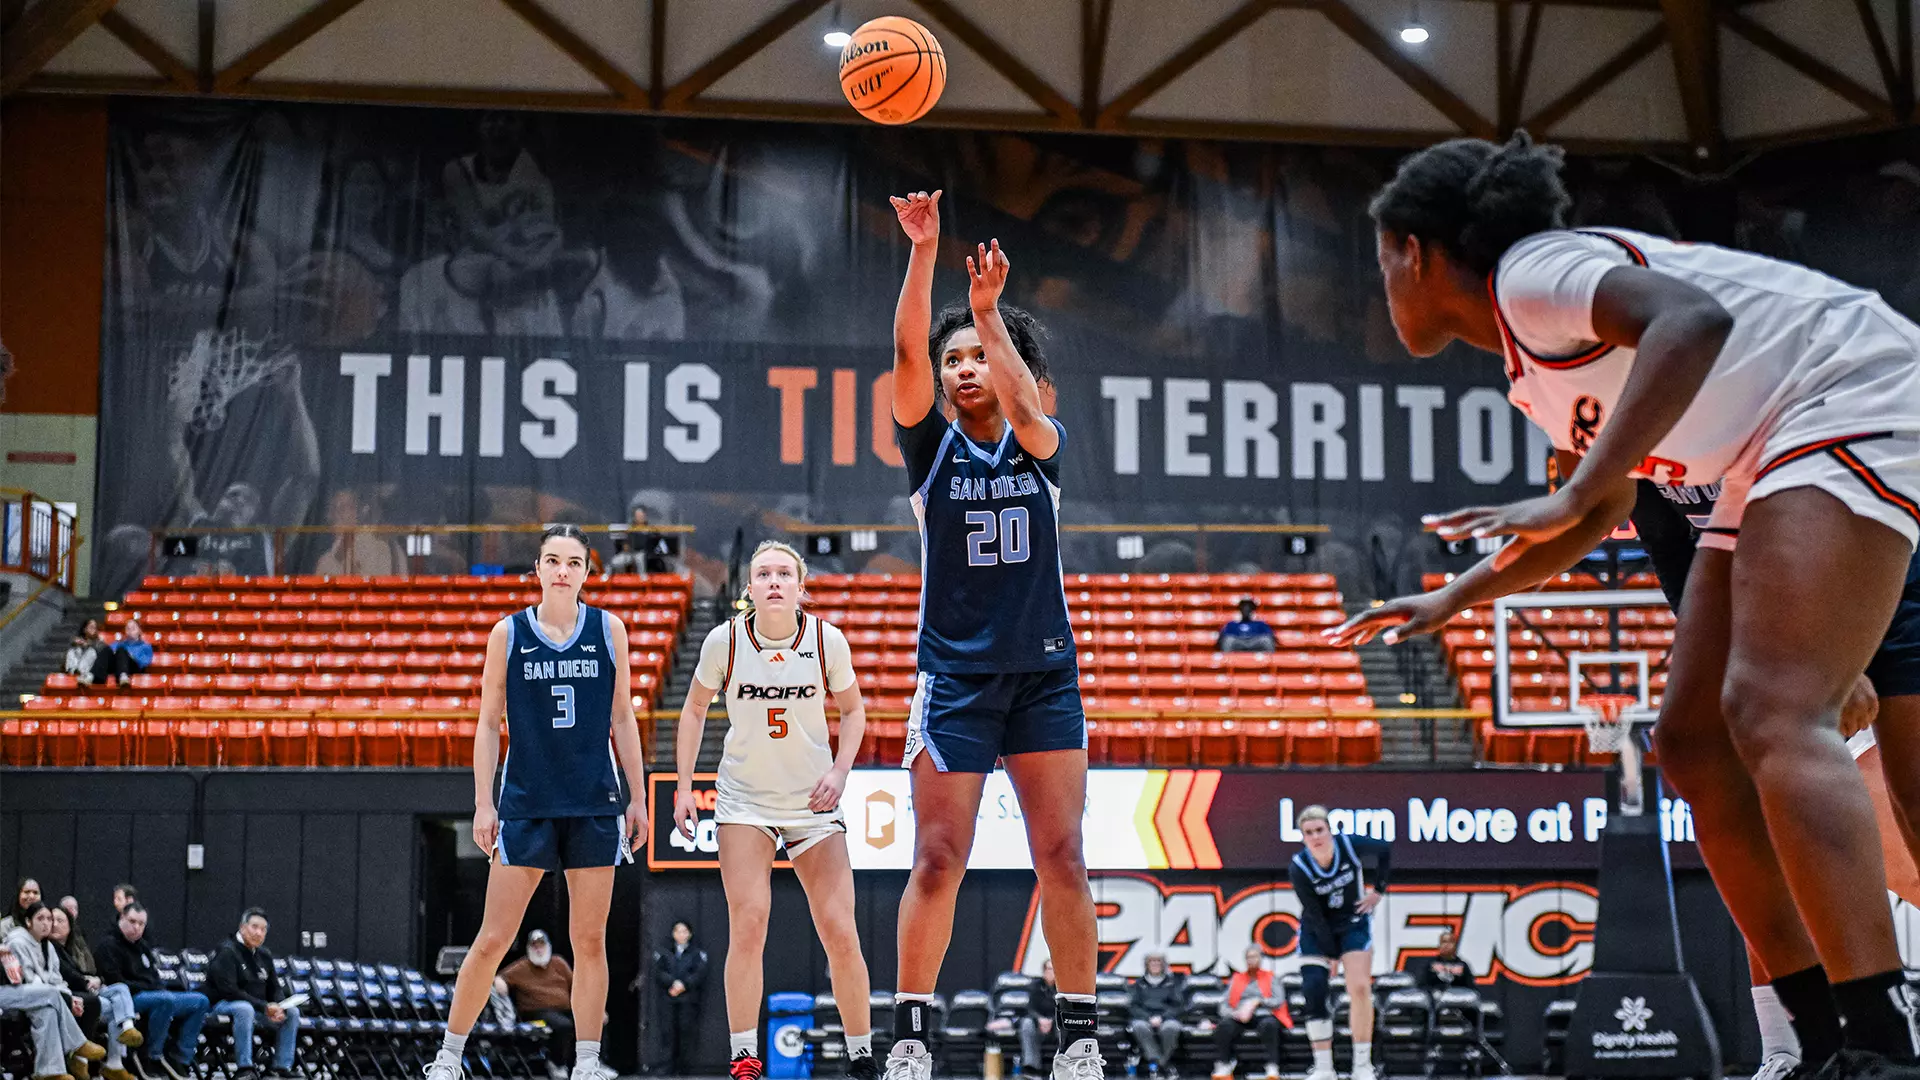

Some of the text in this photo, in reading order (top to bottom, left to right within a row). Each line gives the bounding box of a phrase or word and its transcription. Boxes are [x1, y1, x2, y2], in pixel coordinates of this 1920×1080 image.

[340, 353, 578, 459] THIS
[623, 362, 722, 463] IS
[950, 472, 1040, 500] SAN DIEGO
[965, 506, 1030, 567] 20
[524, 660, 599, 681] SAN DIEGO
[737, 683, 817, 700] PACIFIC
[551, 684, 577, 729] 3
[767, 708, 788, 739] 5
[1279, 798, 1397, 843] Larn
[1408, 798, 1518, 843] More
[1528, 801, 1574, 843] at
[1013, 872, 1599, 986] PACFIC
